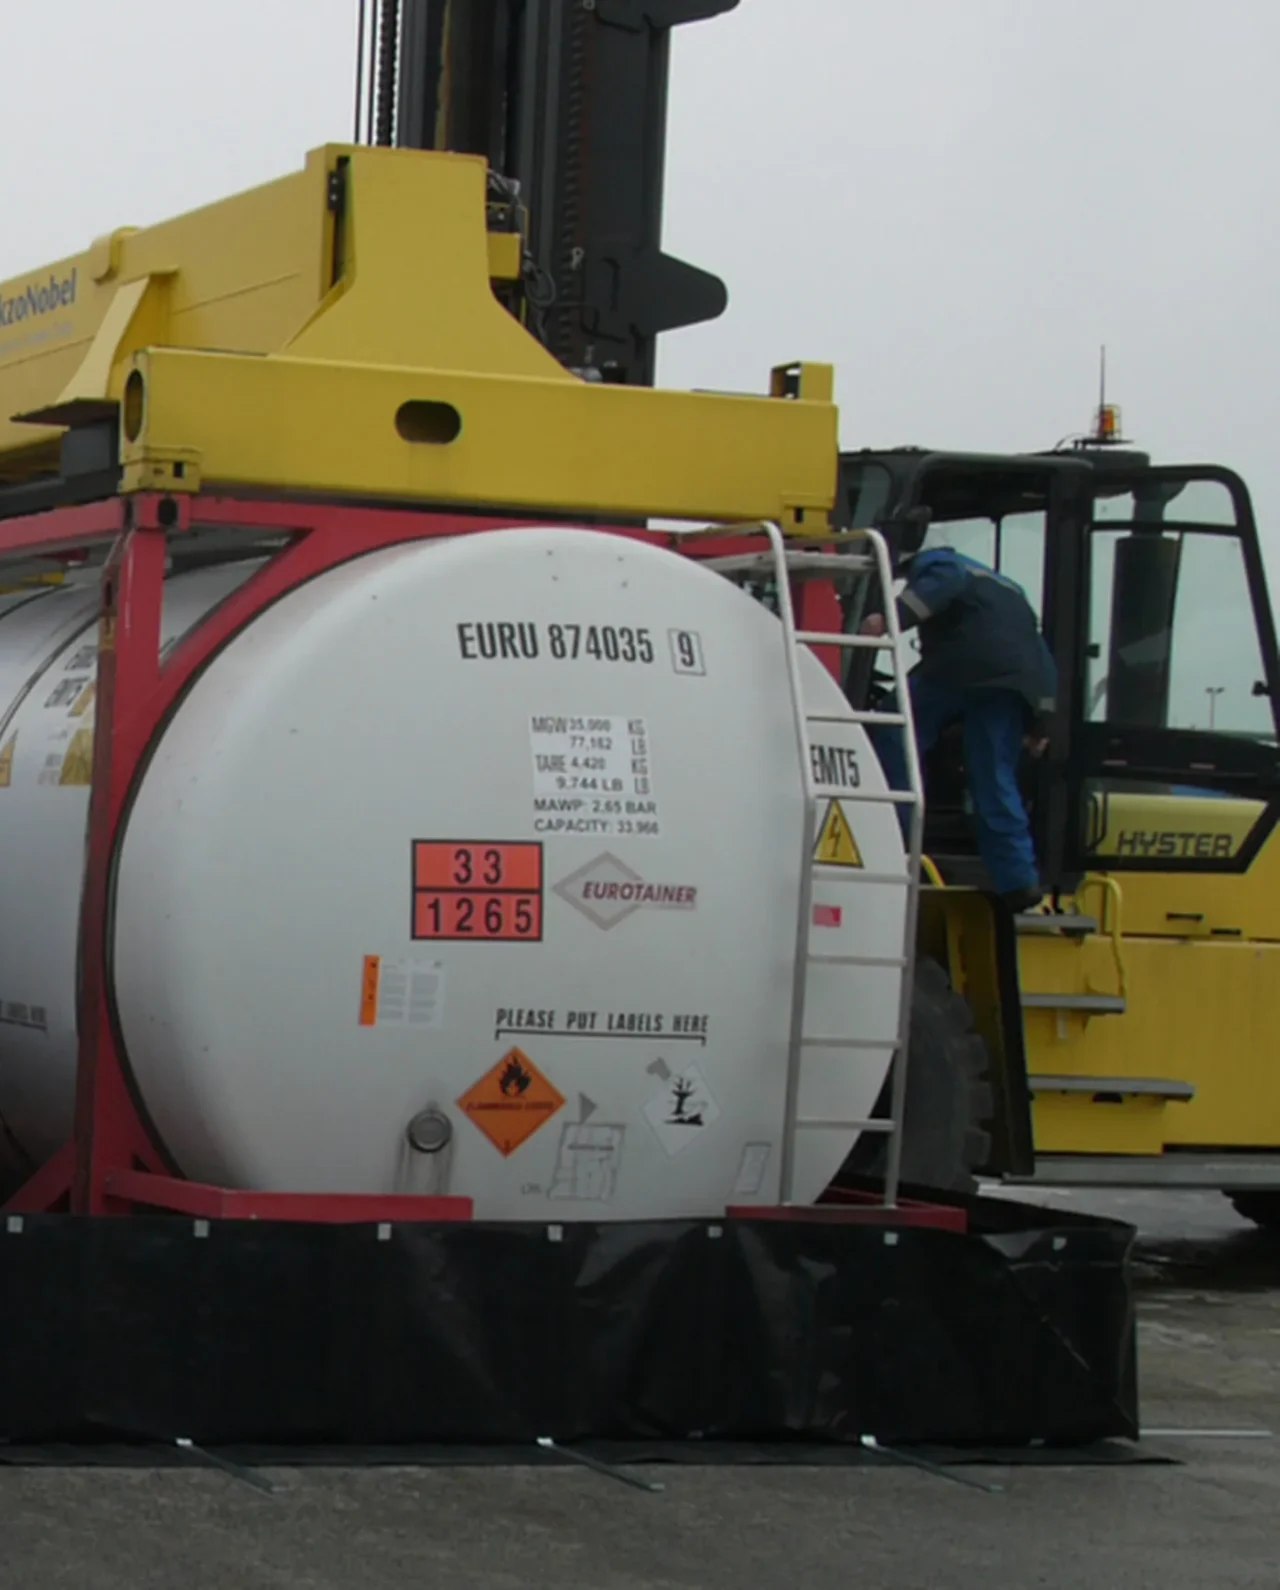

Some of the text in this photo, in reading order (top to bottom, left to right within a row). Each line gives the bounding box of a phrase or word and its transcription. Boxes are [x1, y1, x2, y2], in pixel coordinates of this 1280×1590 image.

[456, 622, 696, 668] EURU 874035 9
[532, 716, 567, 734] MGW
[535, 754, 567, 773] TARE
[810, 744, 861, 788] EMT5
[602, 778, 623, 792] LB
[625, 800, 657, 816] BAR
[1118, 831, 1233, 857] HYSTER
[582, 880, 698, 904] EUROTAINER
[426, 897, 533, 933] 1265
[495, 1008, 709, 1033] PLEASE PUT LABELS HERE
